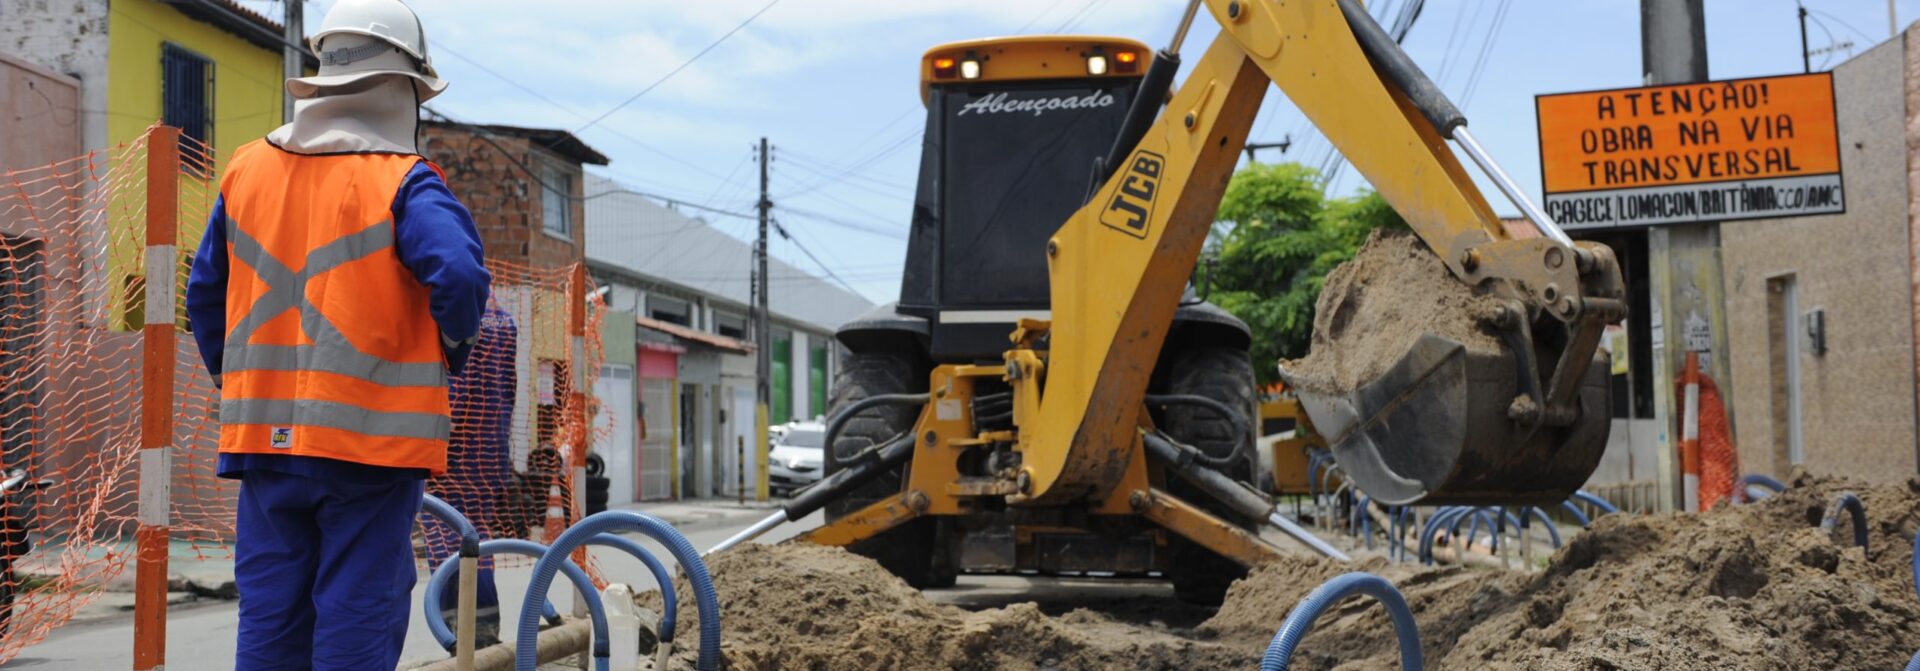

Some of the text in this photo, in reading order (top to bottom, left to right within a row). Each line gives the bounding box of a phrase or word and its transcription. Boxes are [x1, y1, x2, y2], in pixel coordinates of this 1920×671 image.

[957, 89, 1114, 117] Abençoado
[1581, 113, 1794, 154] OBRA NA VIA
[1582, 147, 1801, 186] TRANSVERSAL
[1110, 157, 1160, 230] JCB
